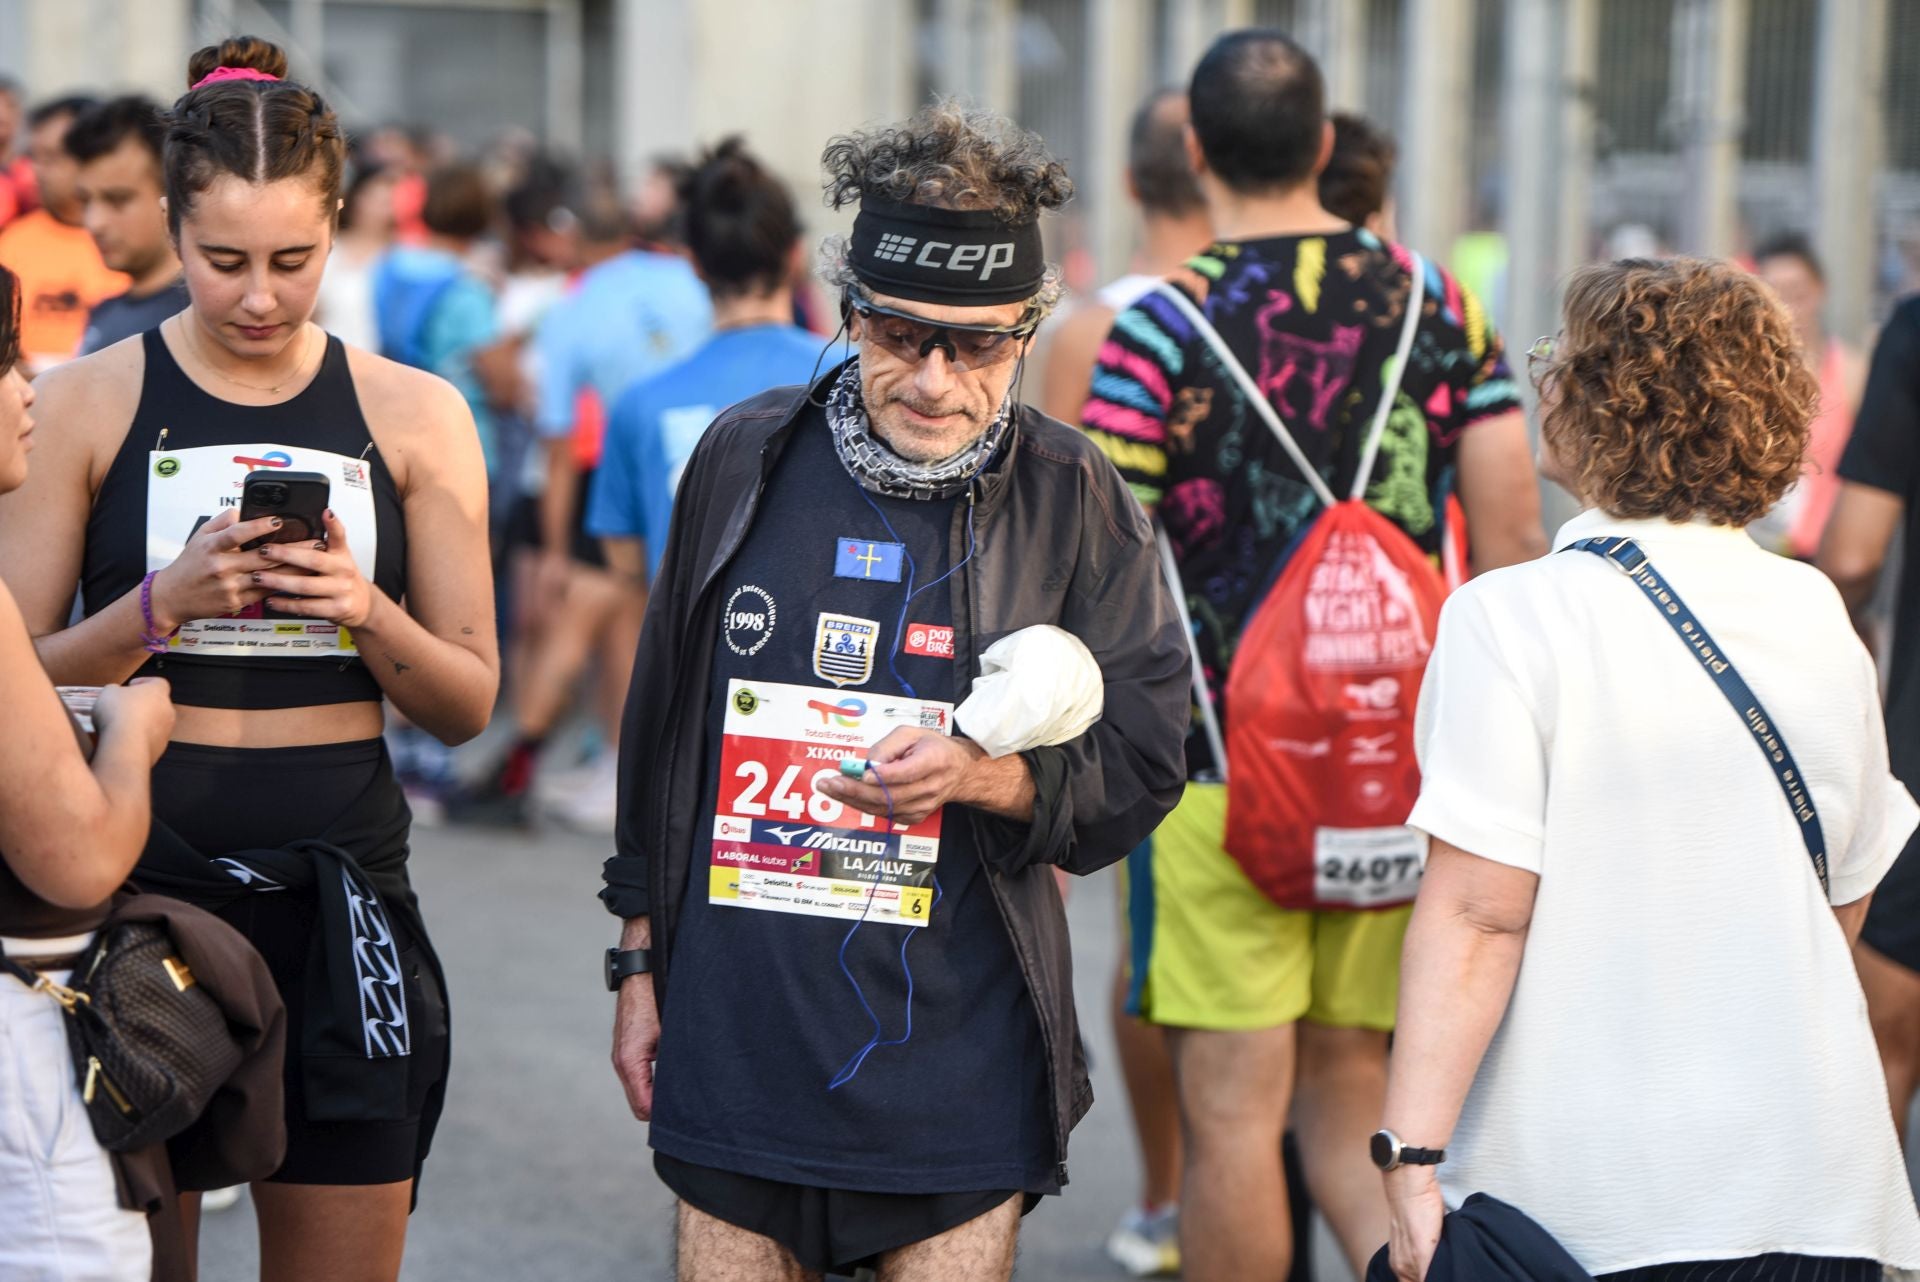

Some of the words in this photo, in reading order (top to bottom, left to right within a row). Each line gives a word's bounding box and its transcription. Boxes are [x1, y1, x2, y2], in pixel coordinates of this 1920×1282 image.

[915, 241, 1015, 281] cep
[729, 611, 766, 632] 1998
[826, 620, 873, 635] BREIZH
[1681, 621, 1729, 675] pierre
[805, 729, 865, 742] TotalEnergies
[1745, 707, 1784, 763] cardin
[806, 746, 857, 761] XIXON
[732, 761, 910, 831] 248
[1783, 769, 1815, 823] pierre
[717, 851, 761, 864] LABORAL
[762, 856, 787, 867] kutxa
[843, 857, 864, 870] LA
[864, 857, 913, 876] SALVE
[1323, 855, 1424, 884] 2607
[911, 898, 922, 914] 6
